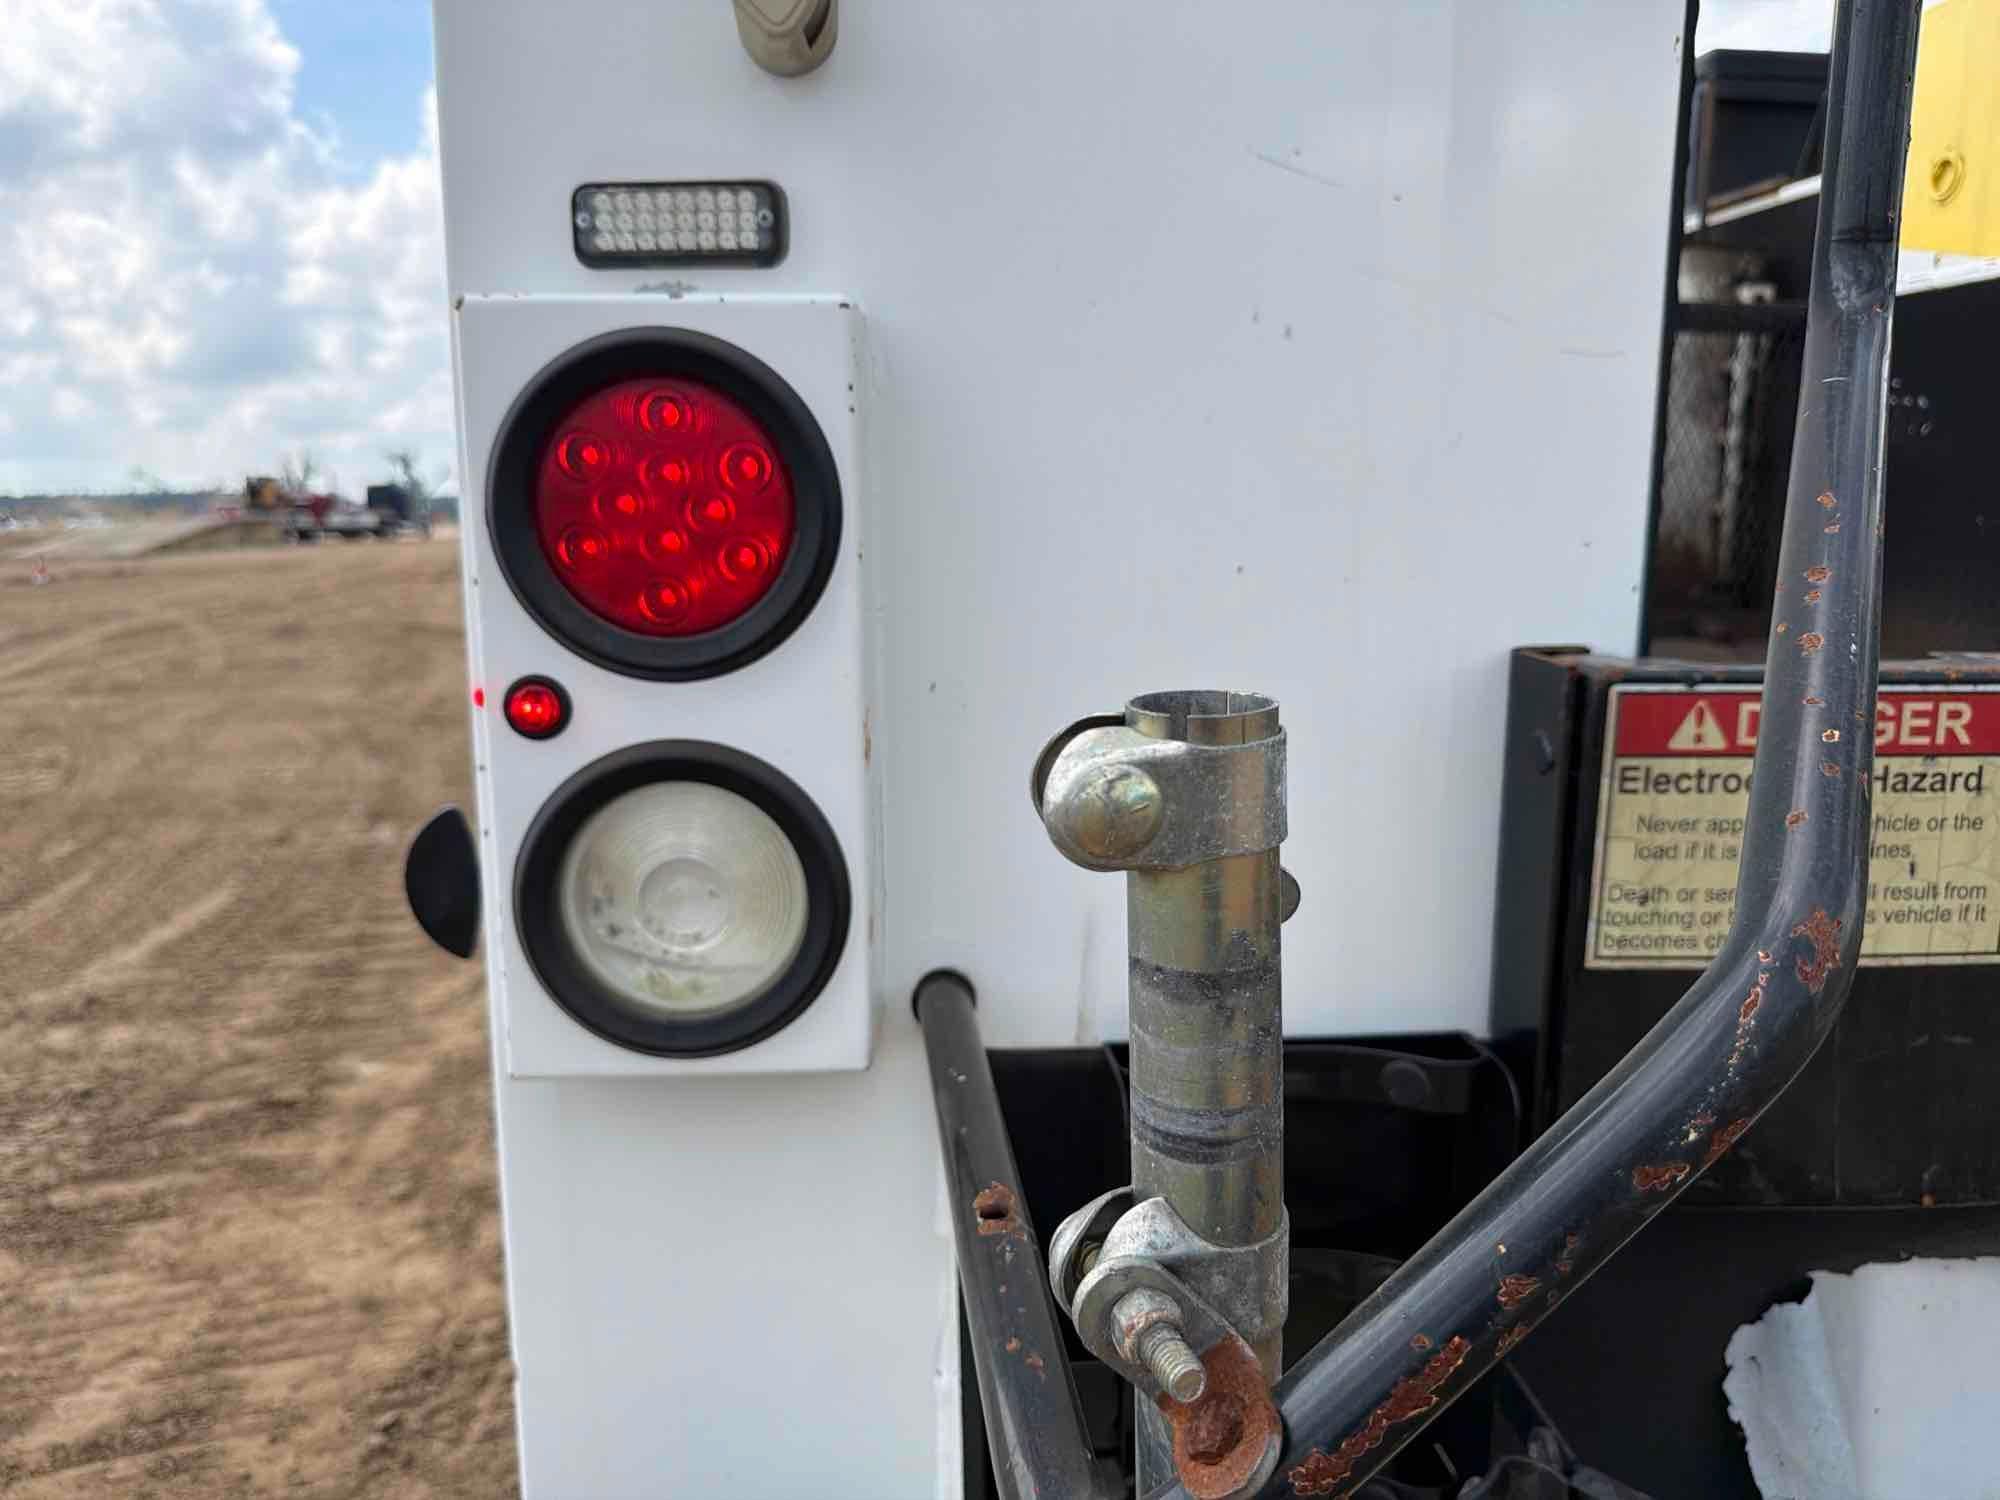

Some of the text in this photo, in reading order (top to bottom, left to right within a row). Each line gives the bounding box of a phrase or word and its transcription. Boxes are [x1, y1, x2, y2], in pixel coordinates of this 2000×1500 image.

[1737, 702, 1972, 746] DGER
[1636, 815, 1699, 834] Never
[1874, 813, 1920, 832] hicle
[1927, 817, 1947, 832] or
[1954, 814, 1984, 831] the
[1633, 841, 1679, 861] load
[1684, 841, 1699, 860] if
[1703, 842, 1715, 860] it
[1721, 843, 1737, 860] is
[1607, 884, 1670, 905] Death
[1676, 888, 1699, 903] or
[1883, 882, 1937, 900] result
[1943, 880, 1987, 900] from
[1605, 908, 1696, 929] touching
[1700, 913, 1721, 927] or
[1883, 904, 1952, 923] vehicle
[1959, 903, 1970, 921] if
[1975, 902, 1986, 922] it
[1603, 931, 1698, 950] becomes
